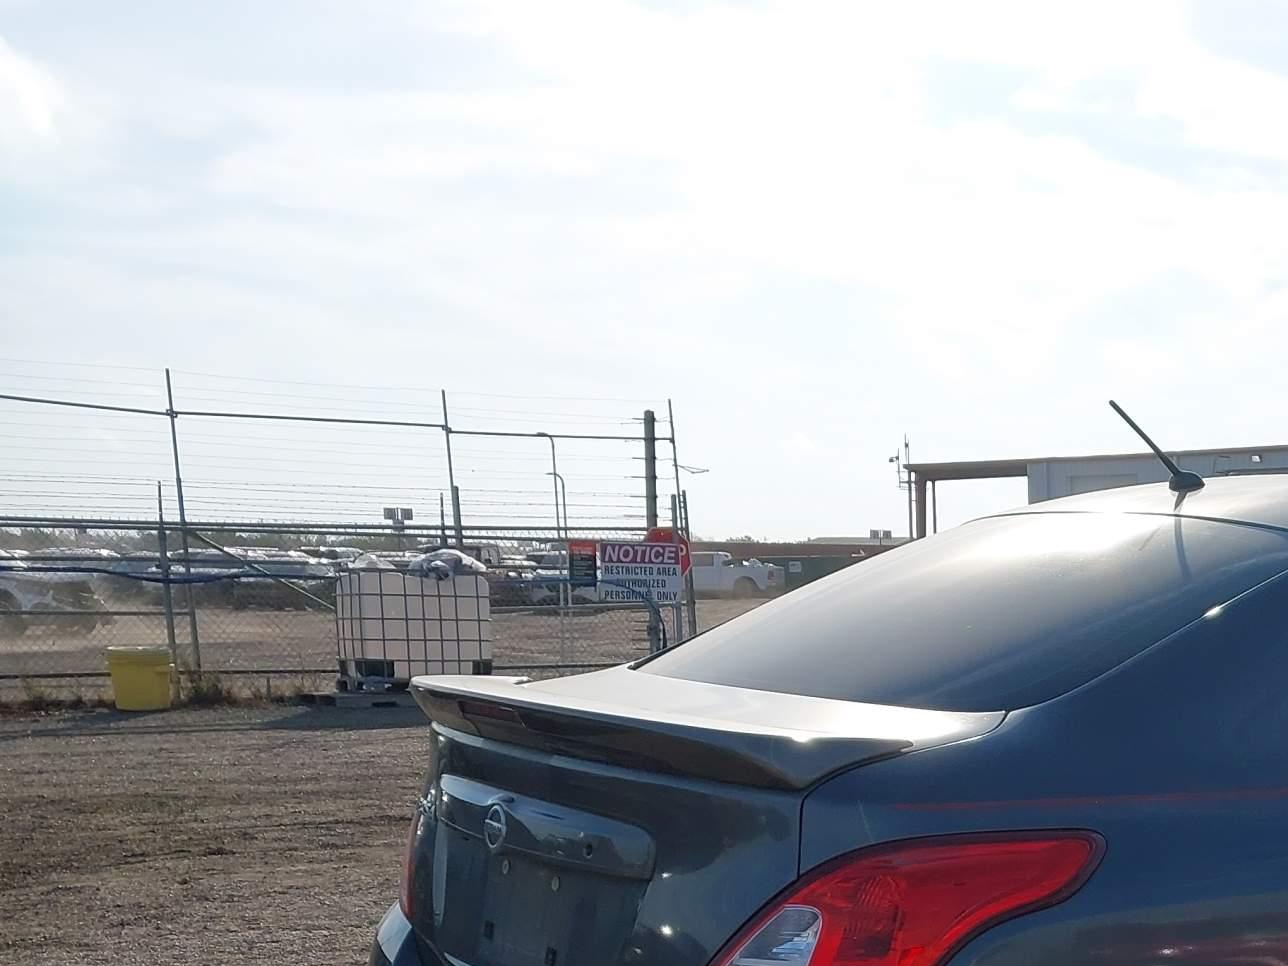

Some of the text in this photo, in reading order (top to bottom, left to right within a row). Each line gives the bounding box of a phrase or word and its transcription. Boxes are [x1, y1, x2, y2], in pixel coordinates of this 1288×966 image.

[604, 544, 676, 563] NOTICE
[604, 565, 677, 577] RESTRICTED AREA
[604, 590, 678, 601] PERSONNE ONLY
